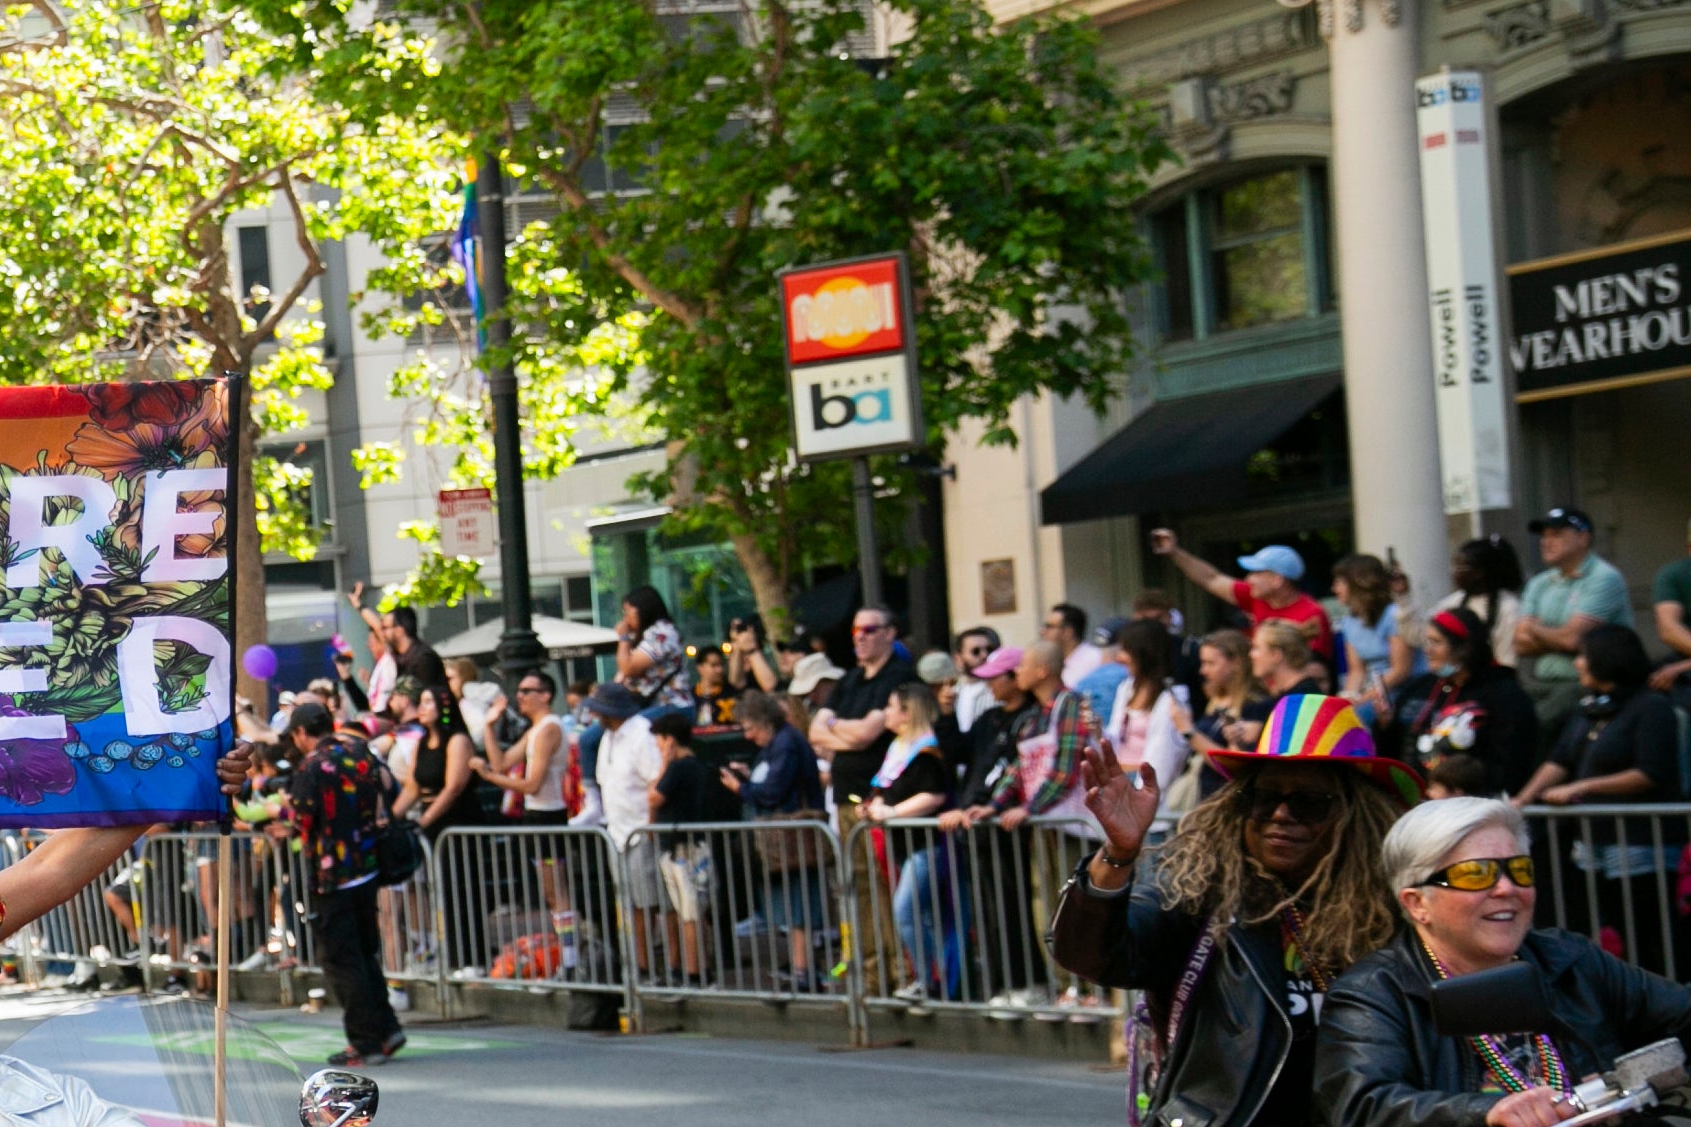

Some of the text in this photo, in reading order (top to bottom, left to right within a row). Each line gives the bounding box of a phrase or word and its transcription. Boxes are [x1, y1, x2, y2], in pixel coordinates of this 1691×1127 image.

[1553, 263, 1682, 323] MEN'S
[1431, 288, 1459, 388] Powell
[1464, 285, 1491, 384] Powell
[830, 373, 891, 388] BART
[1189, 936, 1213, 971] GATE
[1175, 971, 1198, 1002] CLUB
